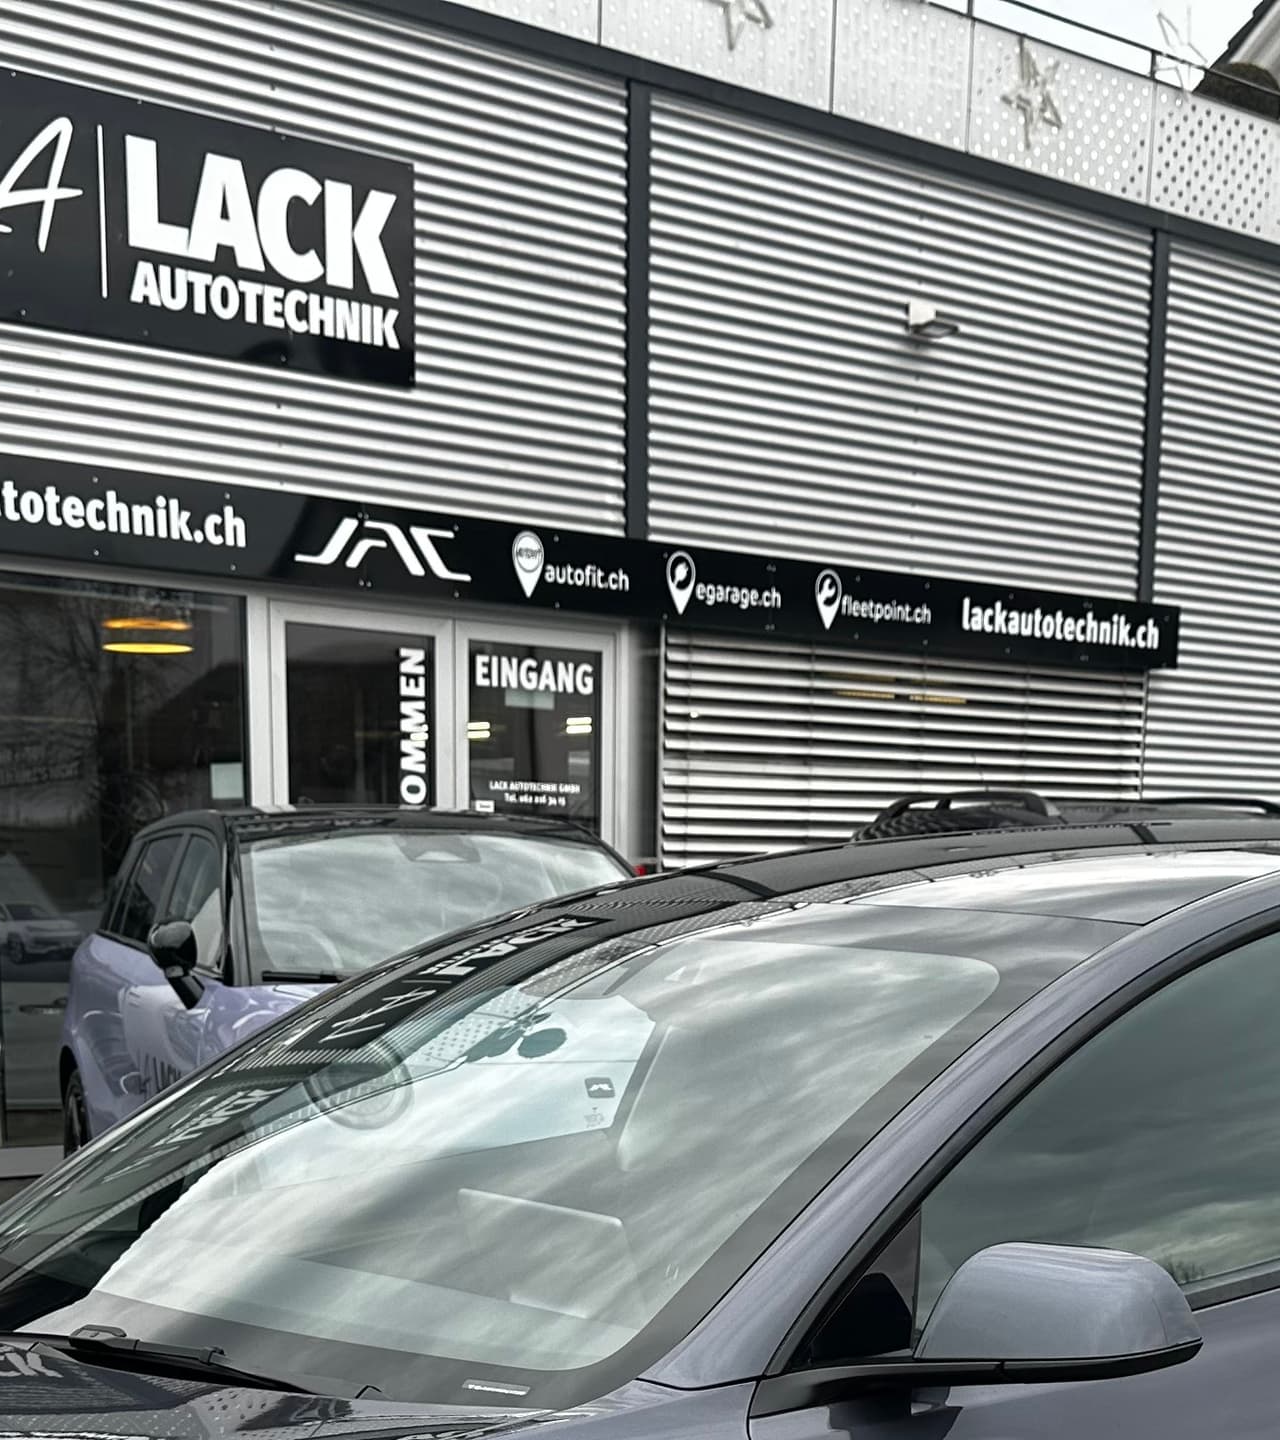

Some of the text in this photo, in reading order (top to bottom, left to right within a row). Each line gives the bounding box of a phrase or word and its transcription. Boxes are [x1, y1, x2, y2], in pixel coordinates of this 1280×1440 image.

[125, 134, 400, 299] LACK
[130, 260, 400, 349] AUTOTECHNIK
[544, 563, 630, 591] autofit.ch
[695, 580, 782, 610] egarage.ch
[841, 597, 932, 625] fleetpoint.ch
[962, 598, 1160, 651] lackautotechnik.ch
[475, 655, 594, 695] EINGANG
[399, 648, 428, 809] OMMEN
